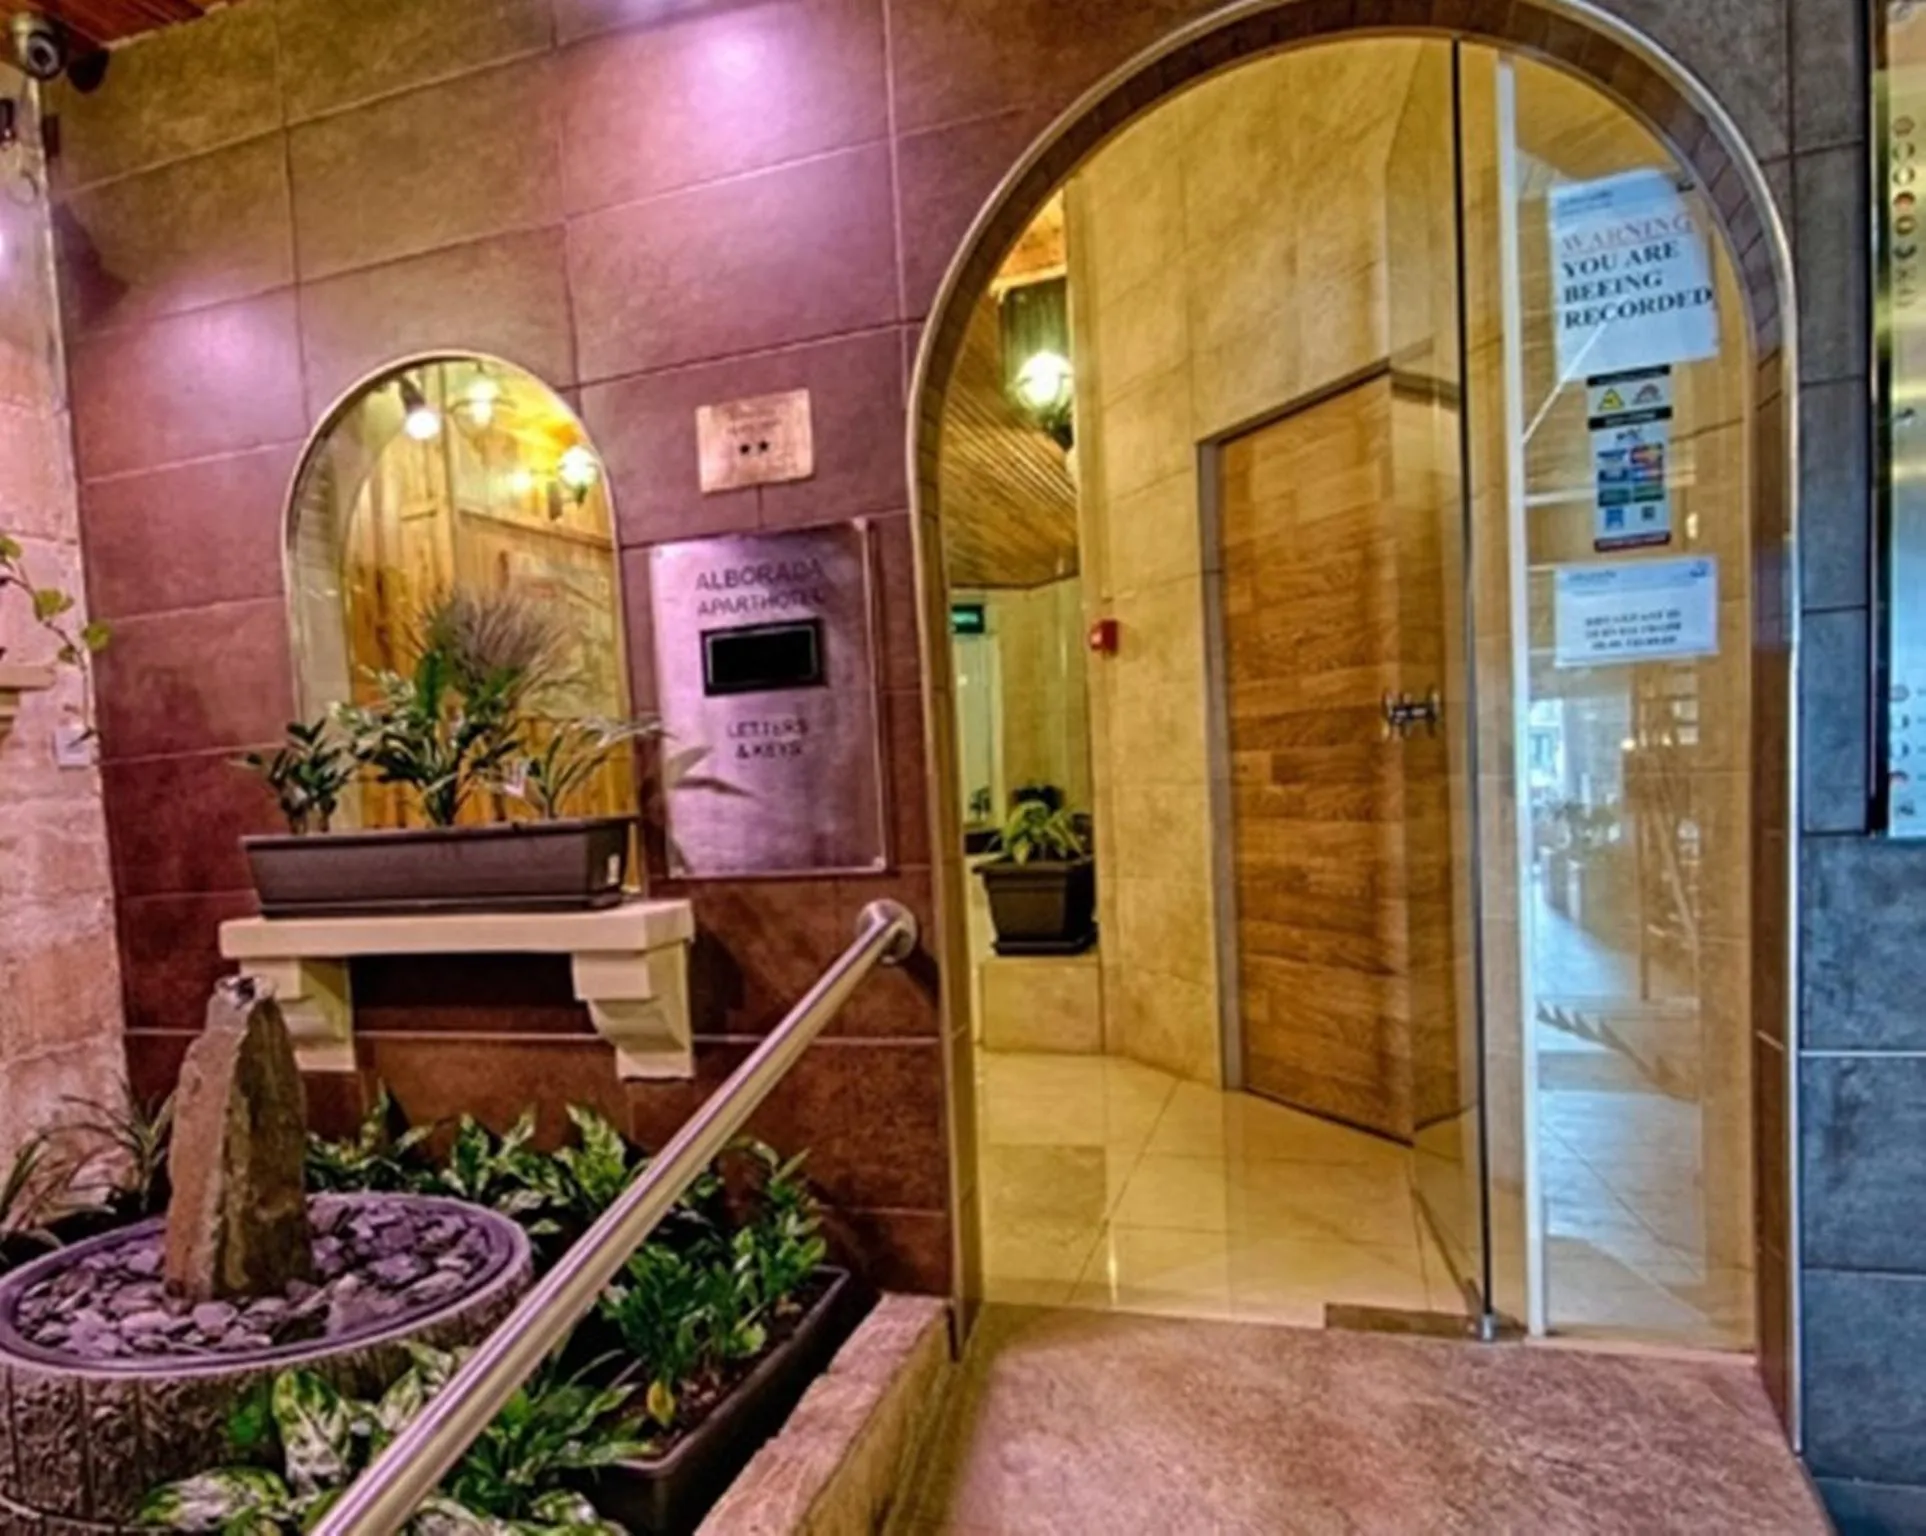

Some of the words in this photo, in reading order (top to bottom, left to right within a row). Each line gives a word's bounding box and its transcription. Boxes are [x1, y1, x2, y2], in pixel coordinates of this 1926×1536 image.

[1562, 212, 1695, 252] WARNING
[1562, 252, 1619, 279] YOU
[1624, 239, 1681, 269] ARE
[1564, 268, 1664, 305] BEEING
[1565, 285, 1714, 330] RECORDED
[696, 558, 826, 591] ALBORADA
[726, 717, 809, 739] LETTERS
